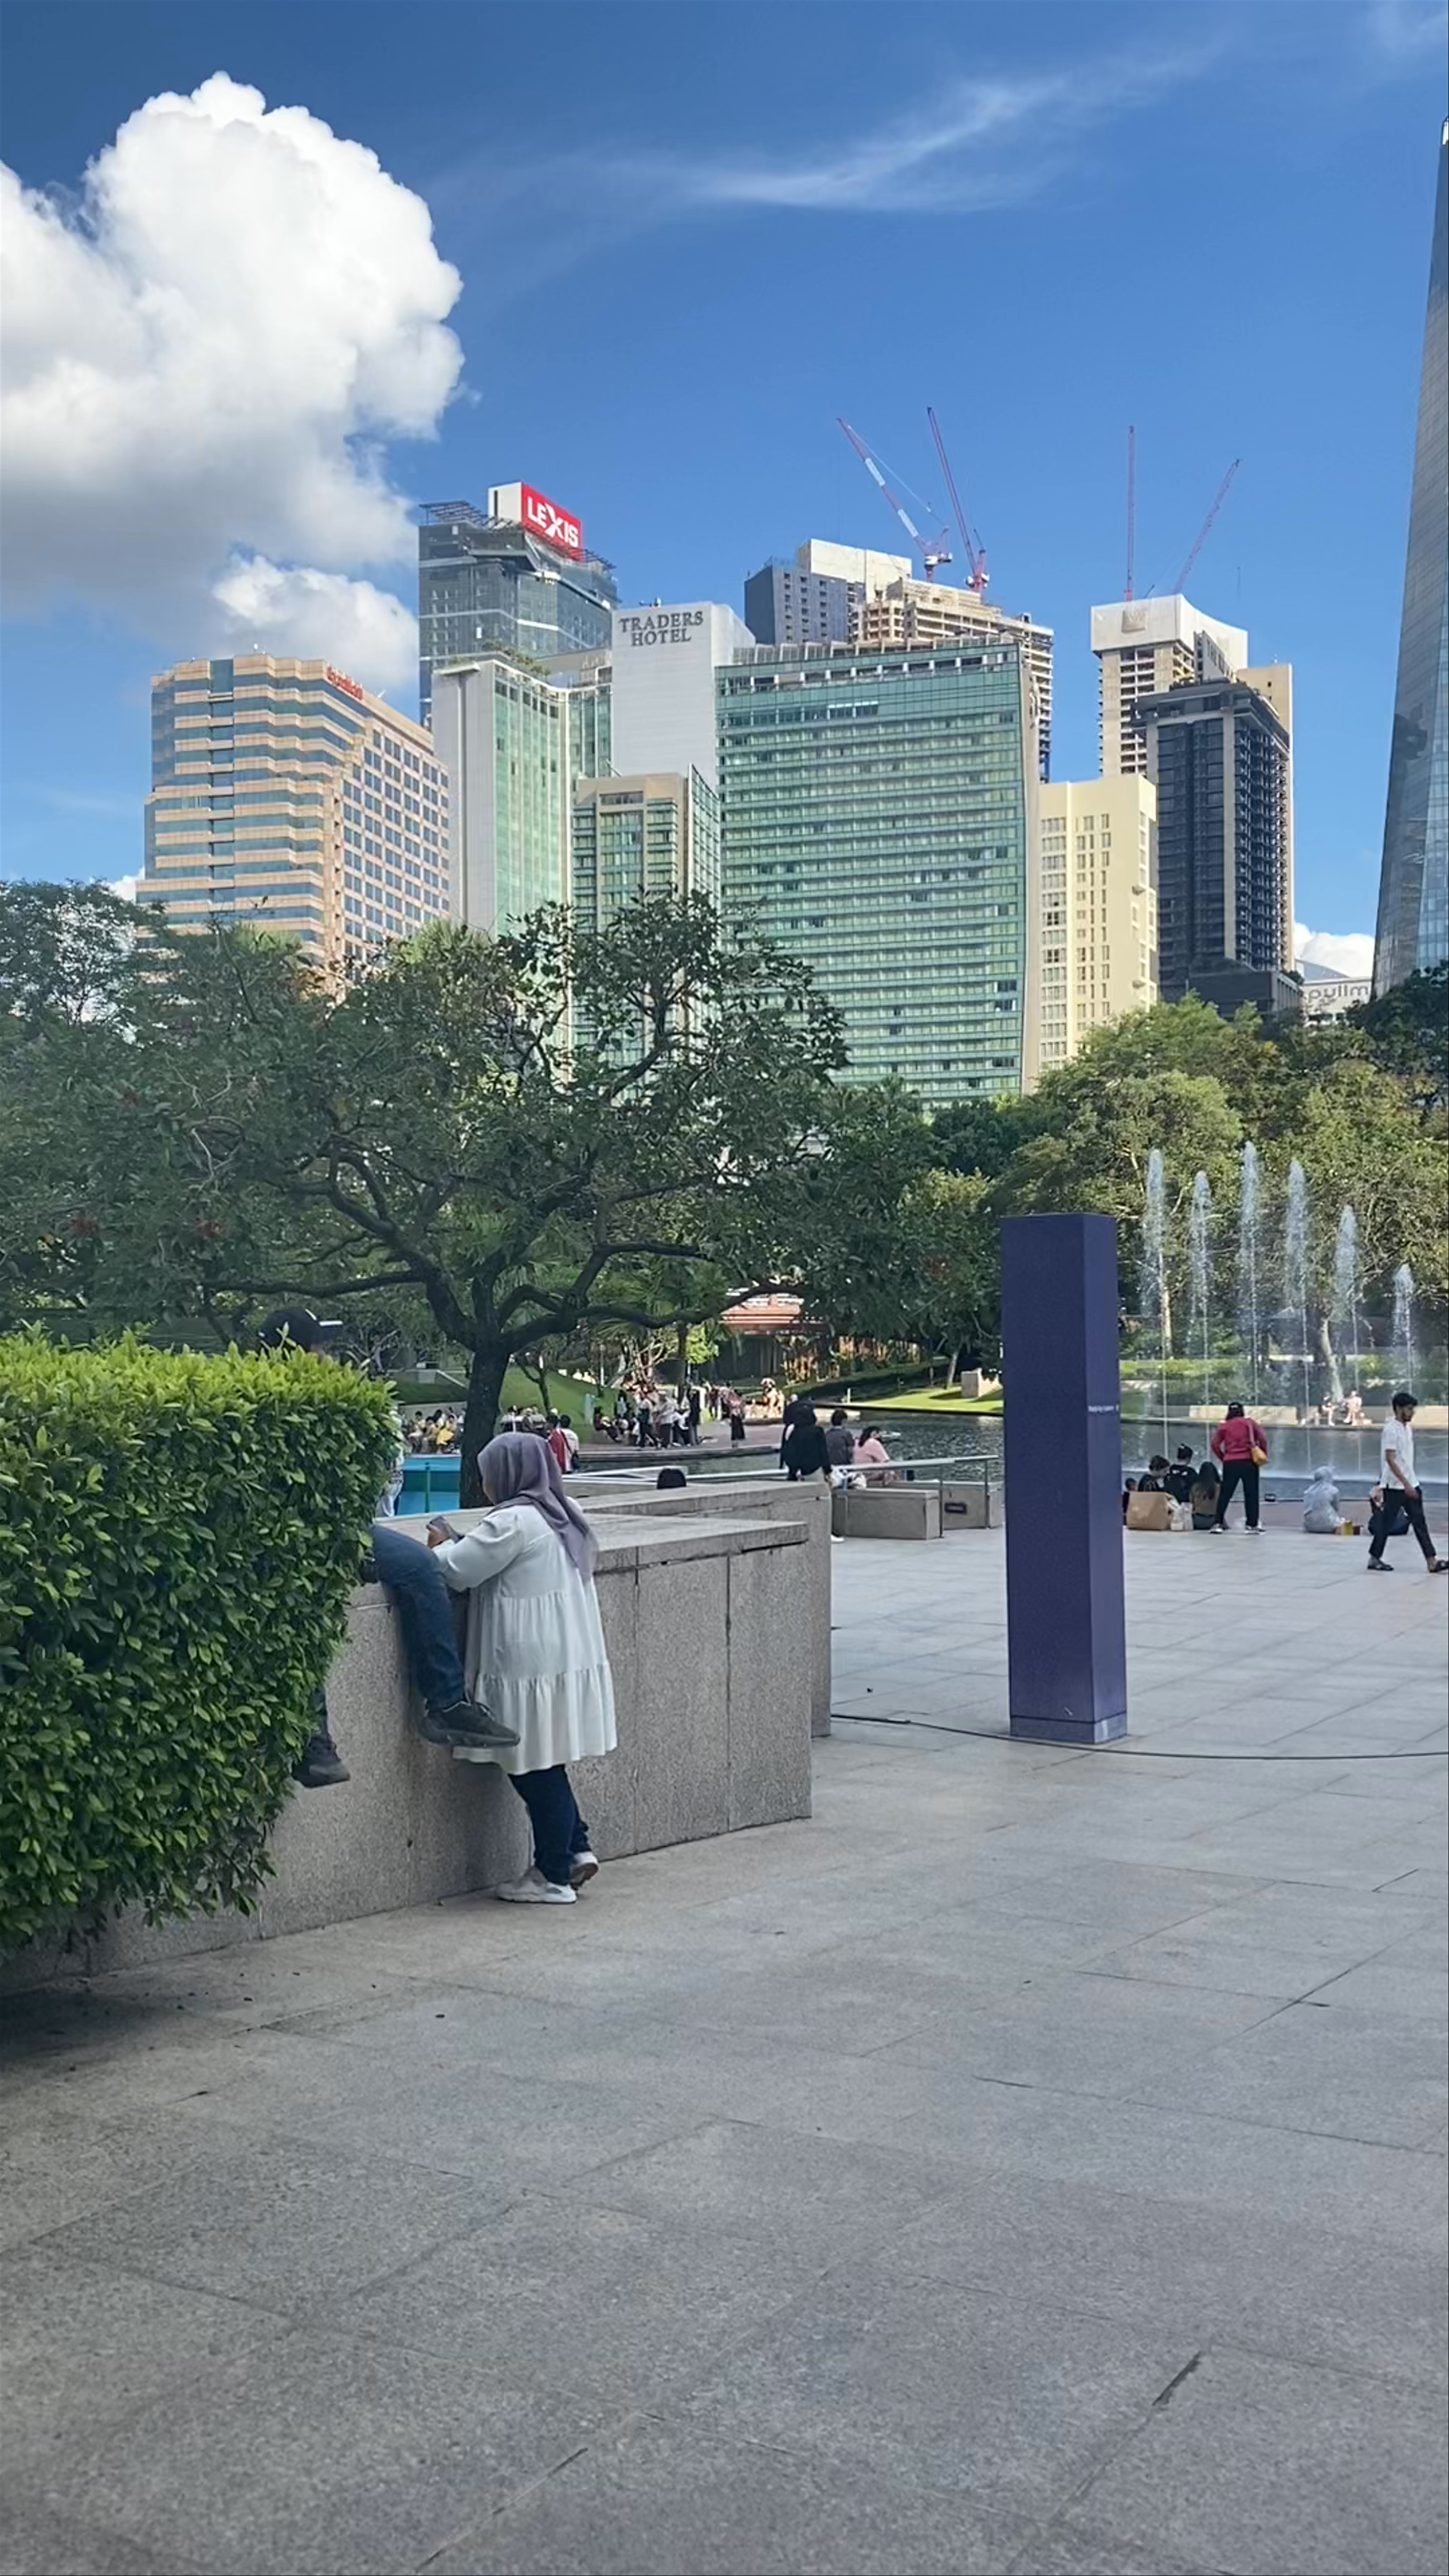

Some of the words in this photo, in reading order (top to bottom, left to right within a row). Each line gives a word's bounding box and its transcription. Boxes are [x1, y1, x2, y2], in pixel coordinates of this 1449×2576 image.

[528, 496, 578, 547] LEXIS
[619, 611, 703, 632] TRADERS
[631, 629, 692, 646] HOTEL
